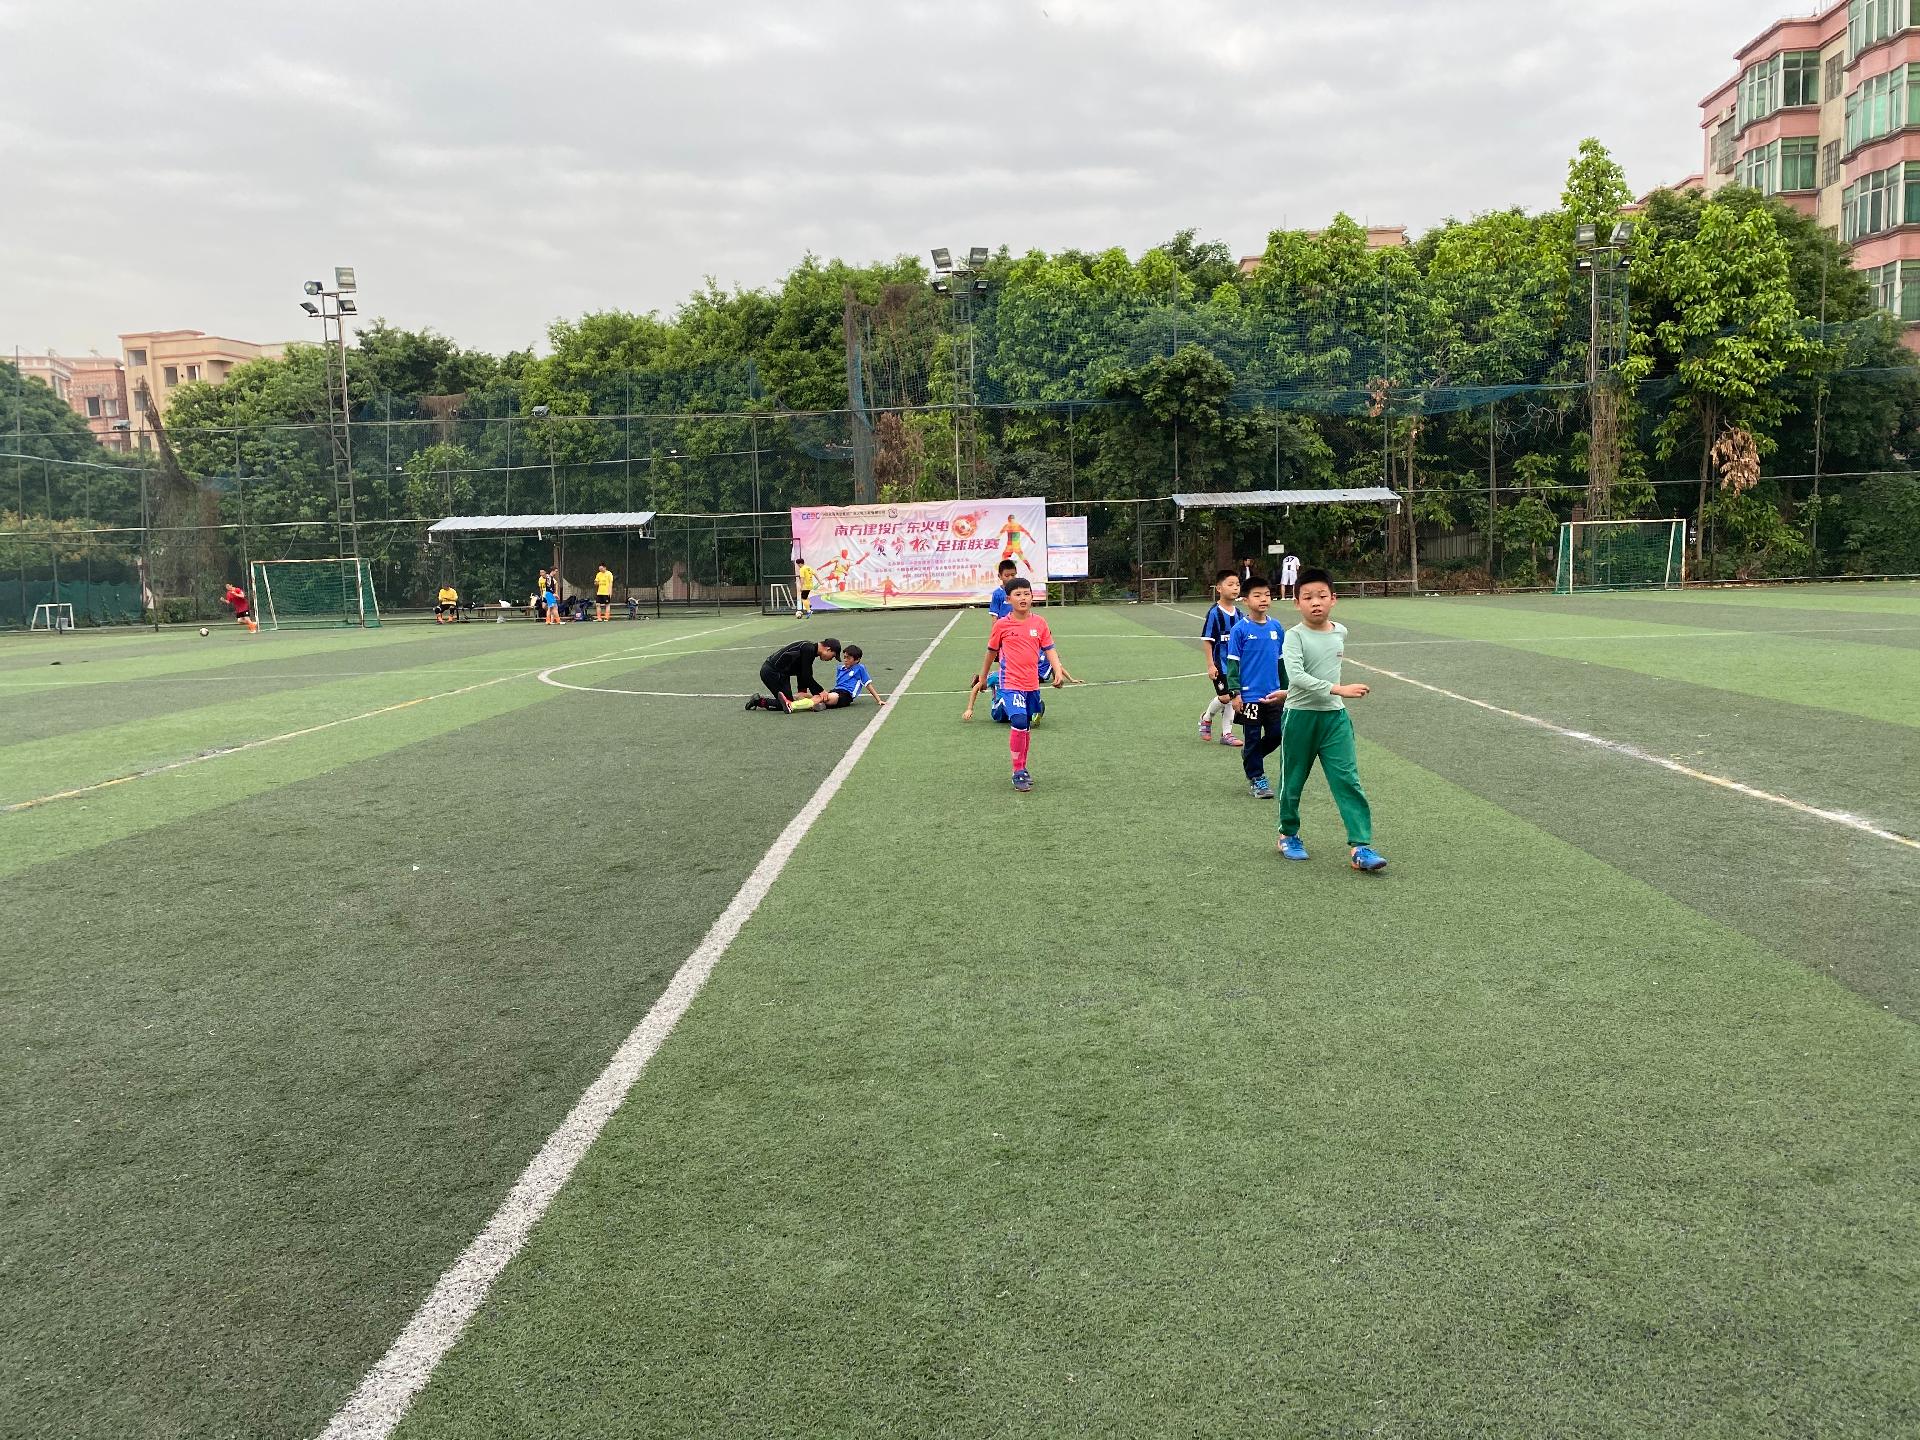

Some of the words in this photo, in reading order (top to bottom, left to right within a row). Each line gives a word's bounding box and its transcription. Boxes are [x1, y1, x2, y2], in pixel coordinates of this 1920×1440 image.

[834, 520, 950, 537] 南方建投广东火电
[1243, 702, 1259, 720] 43
